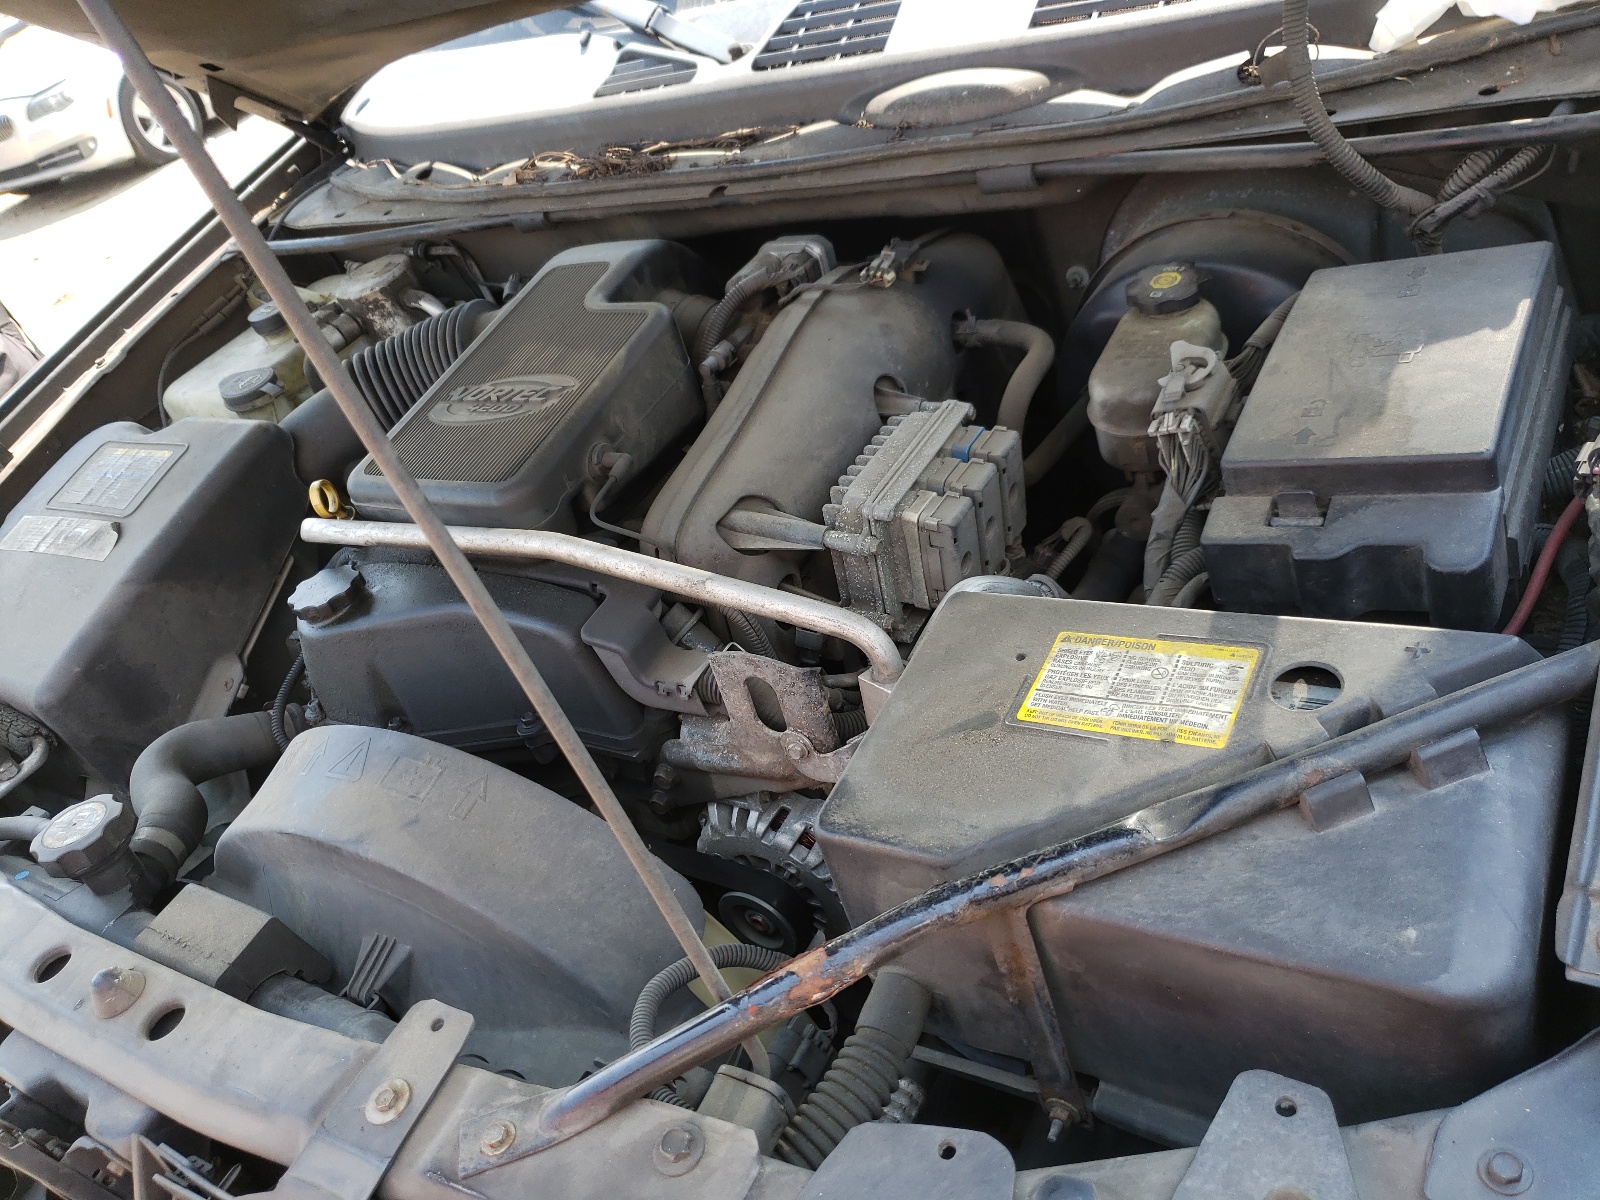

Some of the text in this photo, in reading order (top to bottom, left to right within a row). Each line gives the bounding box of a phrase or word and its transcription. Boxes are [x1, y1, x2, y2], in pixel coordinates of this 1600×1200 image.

[450, 385, 561, 403] VORTEC
[1074, 635, 1156, 650] DANGER/POISON
[1180, 660, 1214, 668] SULFURIC
